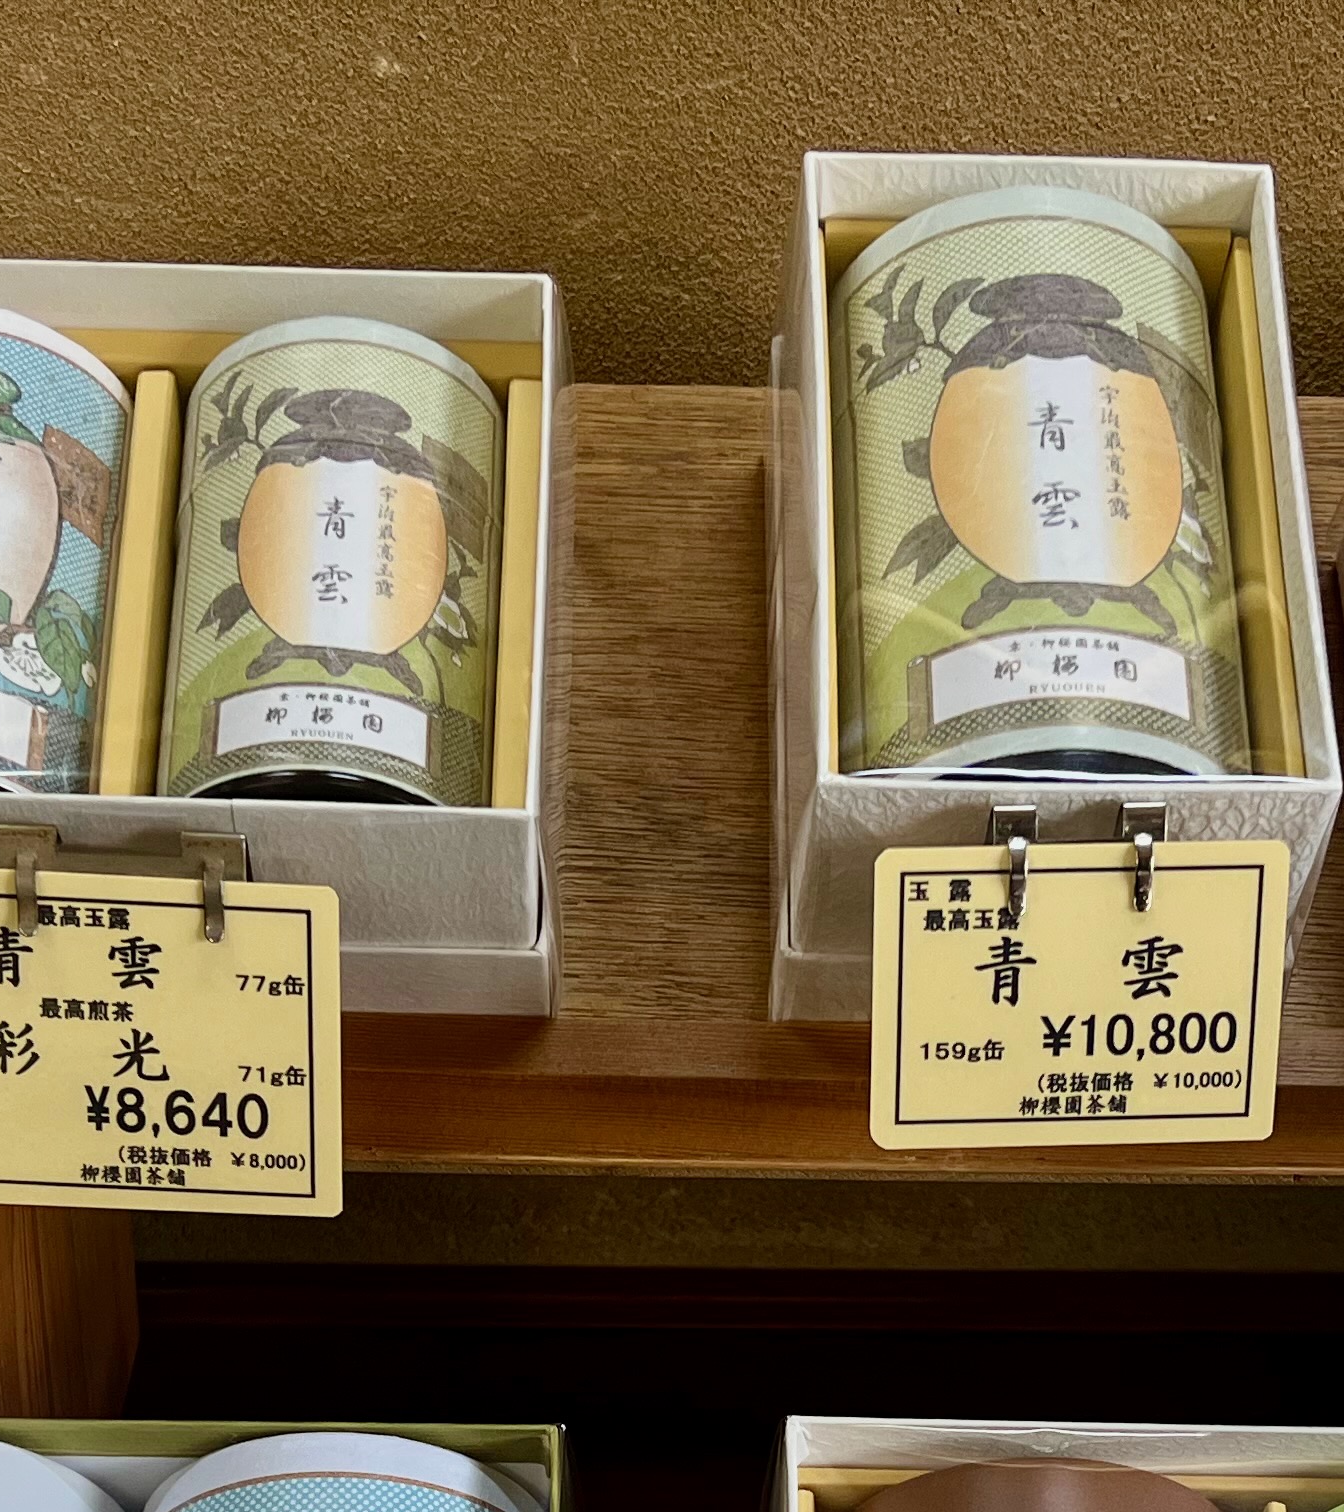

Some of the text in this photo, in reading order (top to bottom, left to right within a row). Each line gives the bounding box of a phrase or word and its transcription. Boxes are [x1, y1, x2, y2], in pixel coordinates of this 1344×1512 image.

[1027, 401, 1082, 531] 青雲
[312, 497, 356, 605] 青雲
[907, 879, 973, 903] 玉露
[37, 905, 131, 931] 最高玉露
[923, 908, 1021, 932] 最高玉露
[974, 935, 1185, 1008] 青雲
[235, 973, 306, 997] 77g缶
[39, 997, 135, 1022] 最高煎茶
[919, 1010, 1238, 1062] 159g缶 ¥10,800
[237, 1064, 307, 1088] 71g缶
[1036, 1068, 1244, 1094] (税抜価格 ¥10,000)
[84, 1085, 269, 1140] ¥8,640
[118, 1146, 306, 1172] (税抜価格 ¥8,000)
